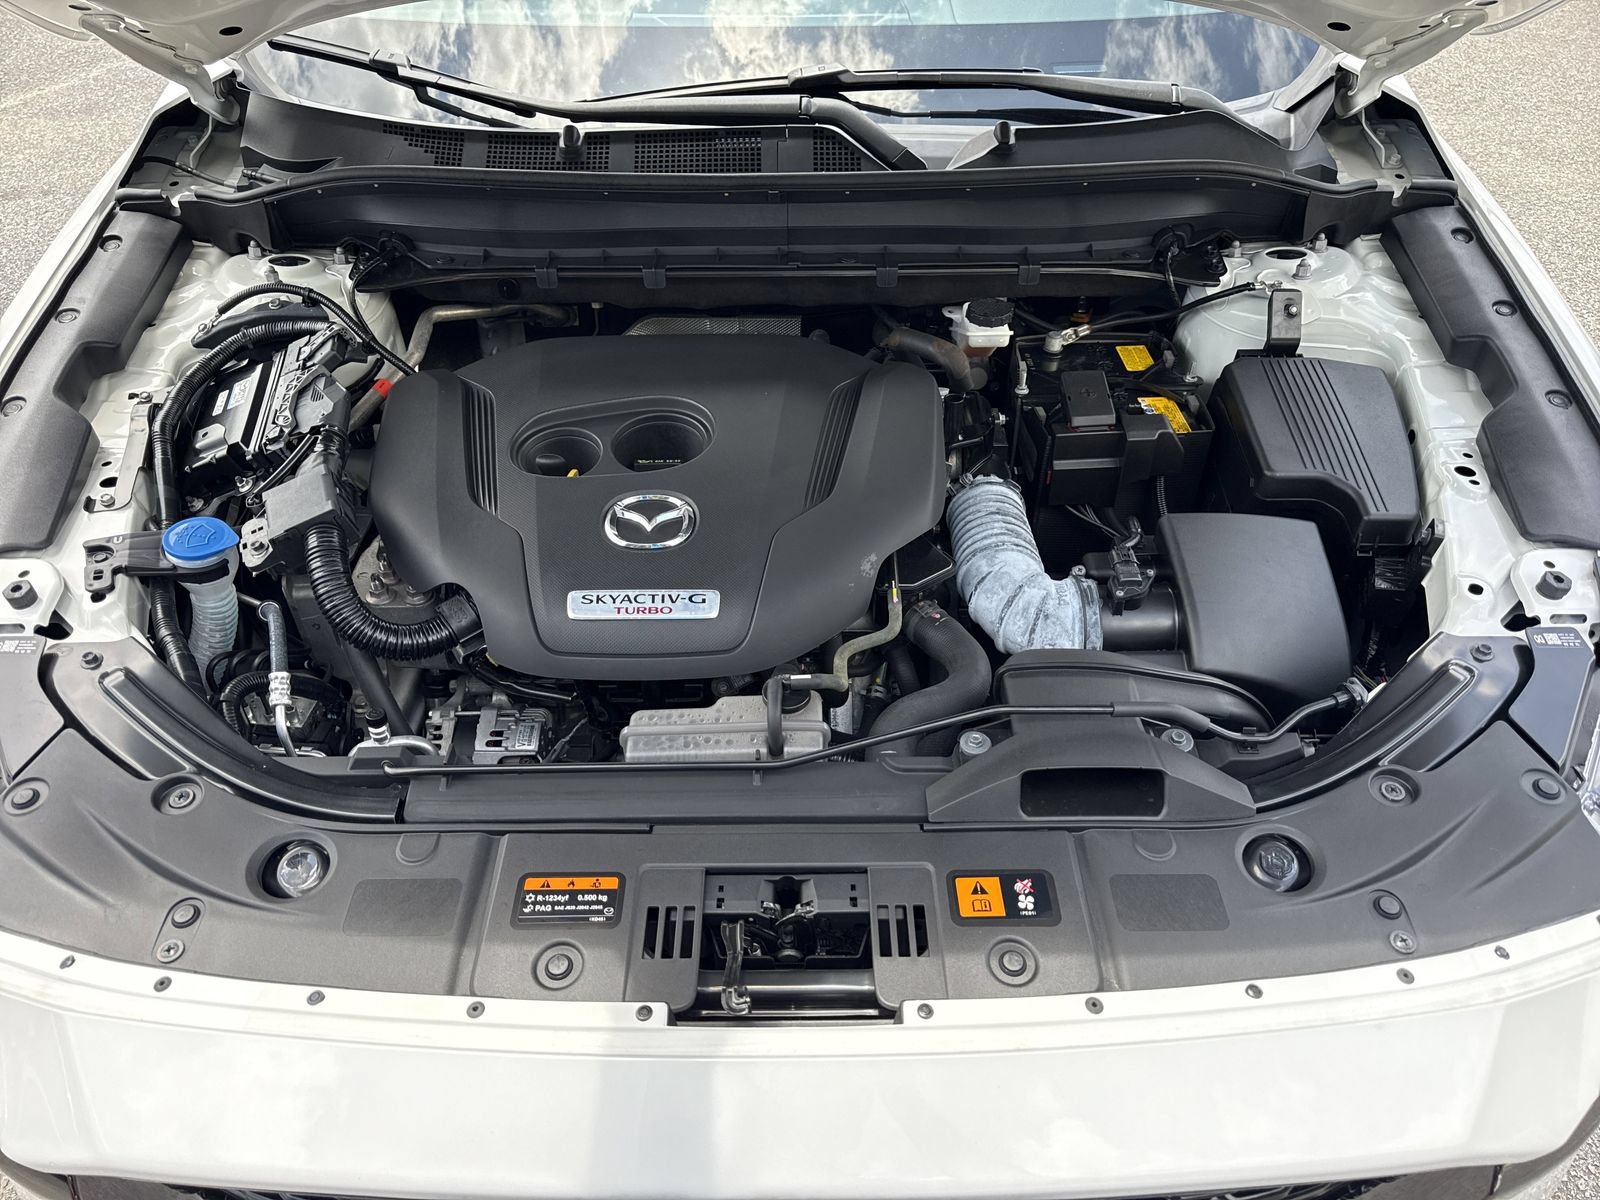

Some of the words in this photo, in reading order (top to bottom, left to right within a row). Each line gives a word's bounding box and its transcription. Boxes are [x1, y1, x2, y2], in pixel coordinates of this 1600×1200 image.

[580, 593, 706, 605] SKYACTIV-G
[613, 606, 673, 615] TURBO
[536, 894, 569, 903] R-1234yf
[577, 894, 597, 902] 0.500
[598, 894, 608, 902] kg
